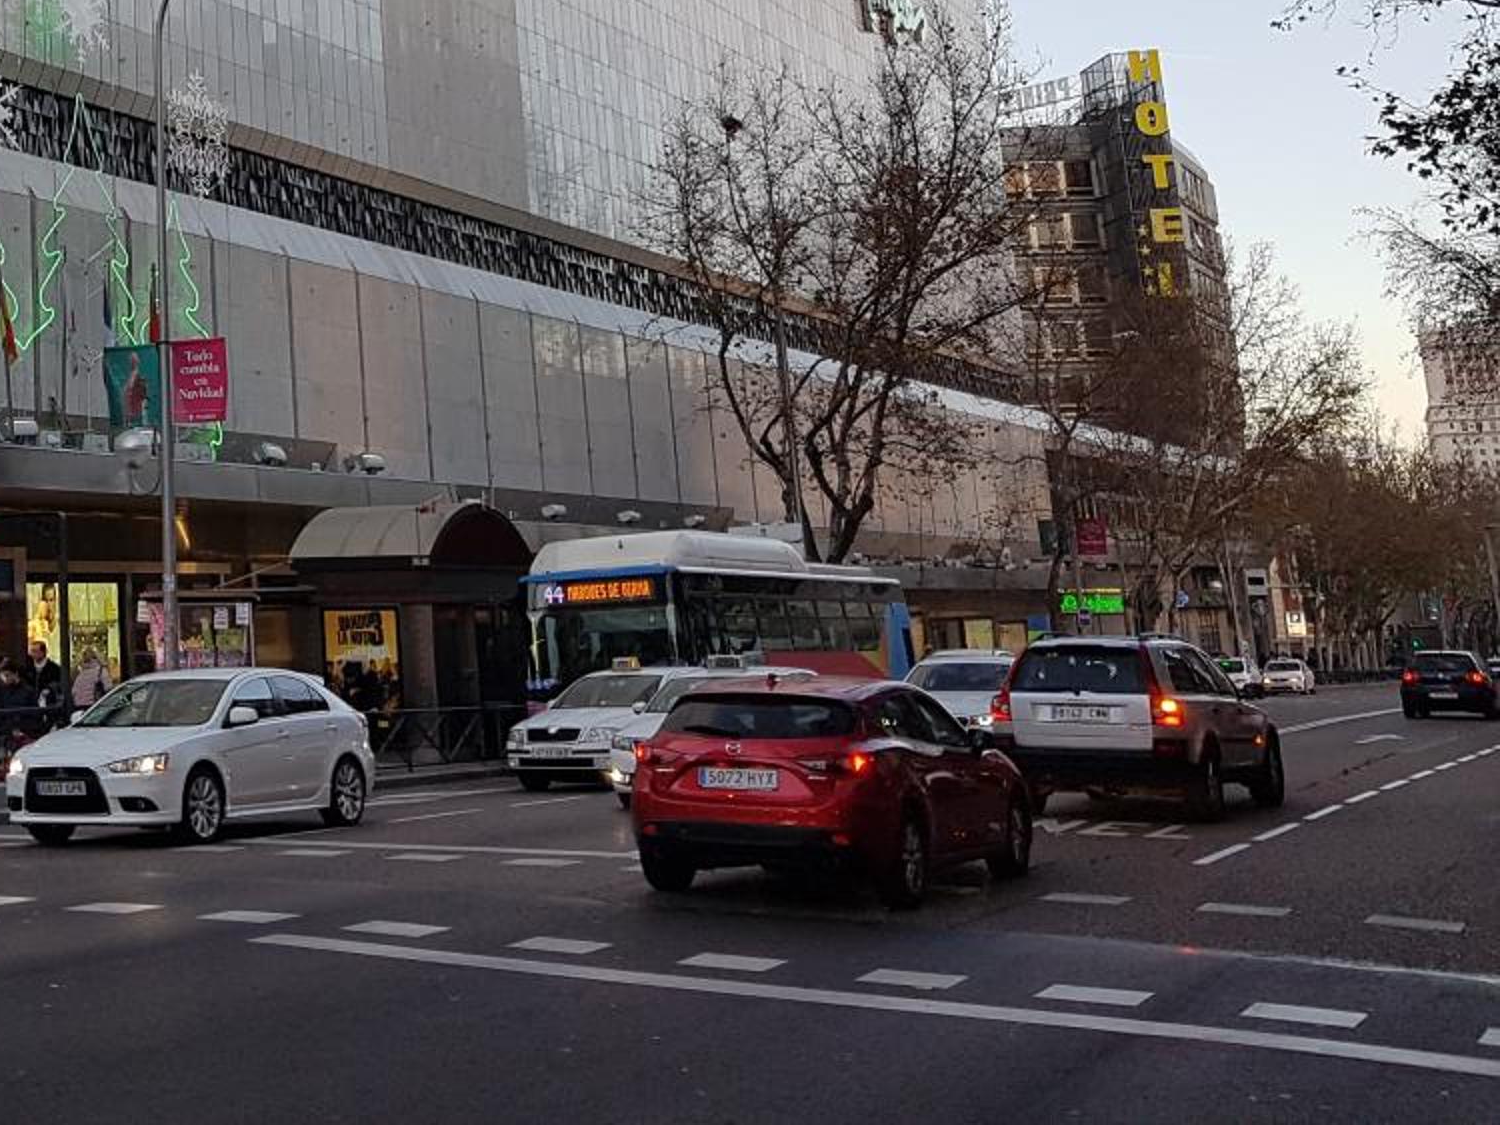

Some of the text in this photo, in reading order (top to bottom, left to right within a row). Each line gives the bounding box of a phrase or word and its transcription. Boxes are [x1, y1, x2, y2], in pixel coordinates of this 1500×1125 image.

[180, 361, 220, 375] cambia
[193, 377, 209, 387] en
[179, 386, 224, 400] Navidad
[544, 585, 565, 604] 44
[709, 769, 744, 785] 5072
